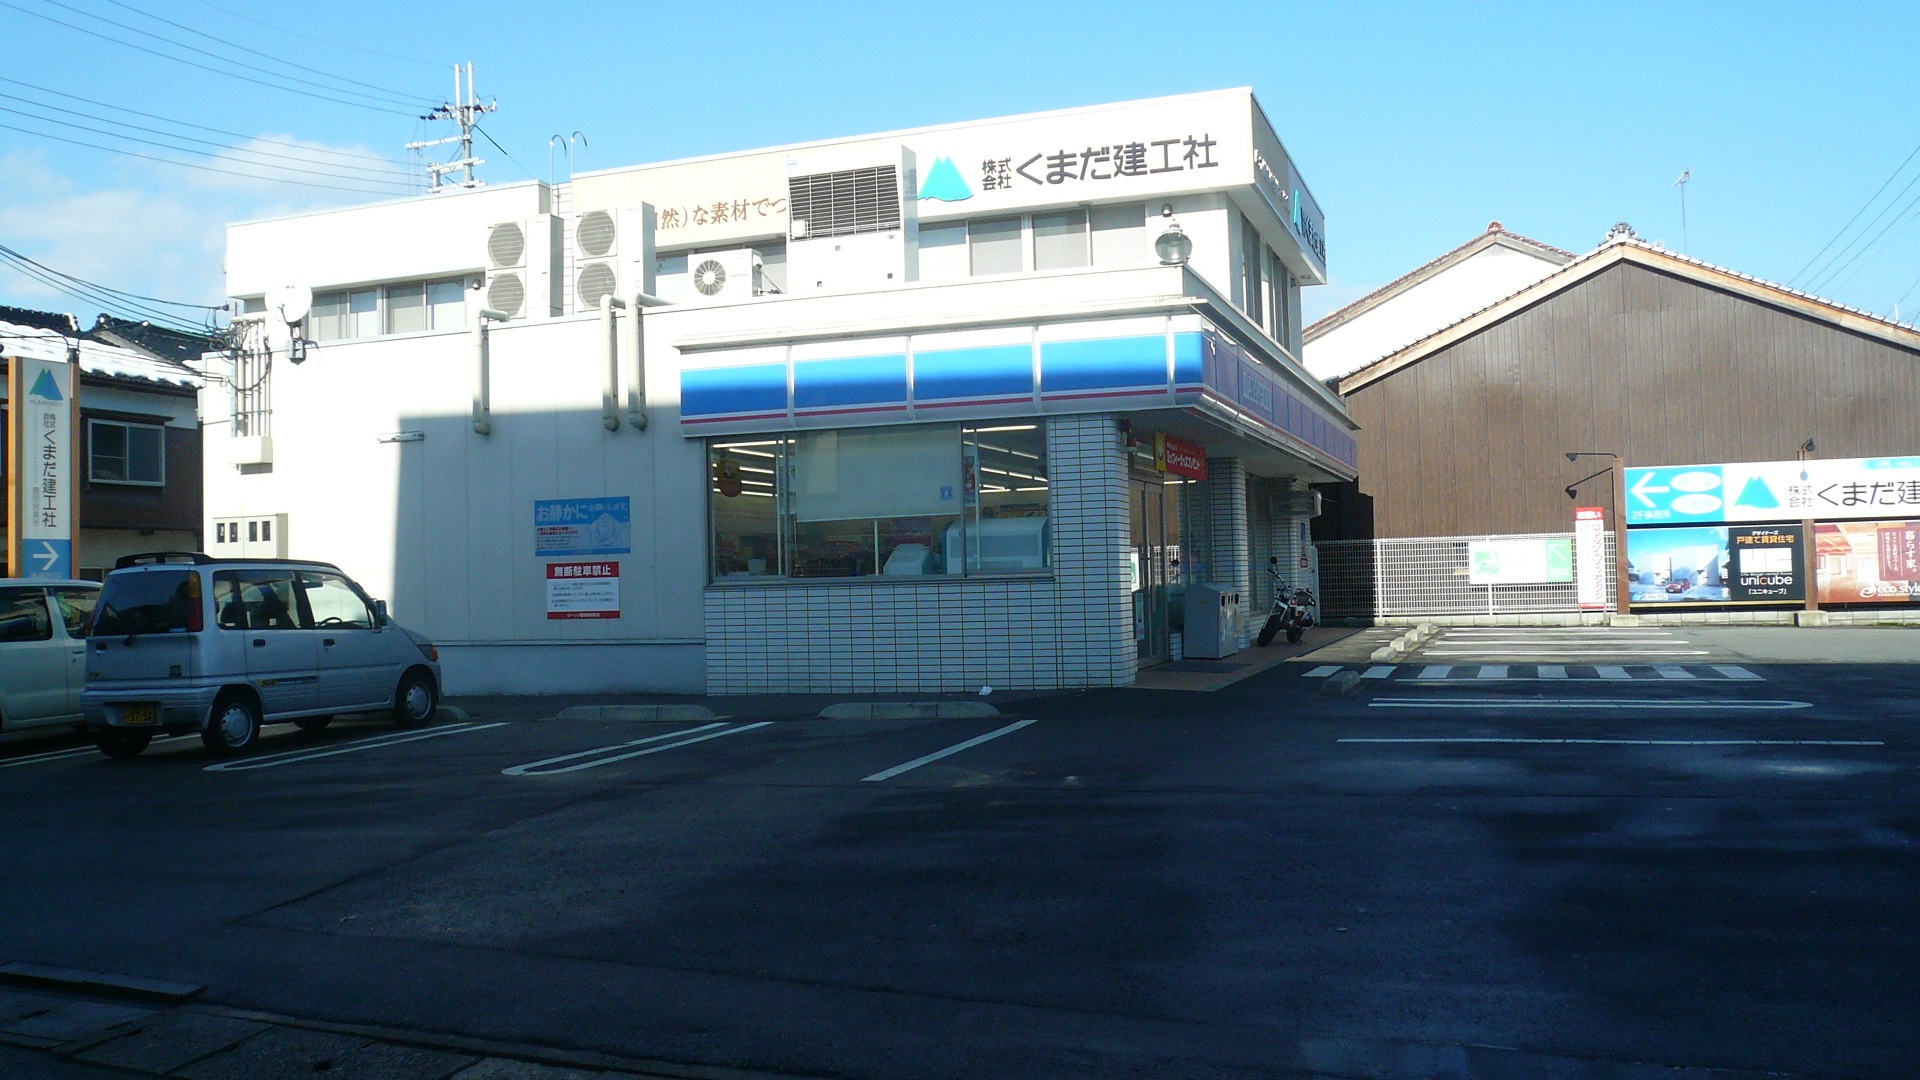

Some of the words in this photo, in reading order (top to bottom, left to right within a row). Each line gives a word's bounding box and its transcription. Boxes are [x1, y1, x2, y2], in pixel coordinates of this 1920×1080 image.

[1015, 133, 1218, 186] くまだ建工社
[42, 429, 57, 528] くまだ建工社
[554, 564, 612, 577] 無断駐車禁止
[1740, 575, 1793, 586] unicube
[1877, 585, 1897, 593] eco
